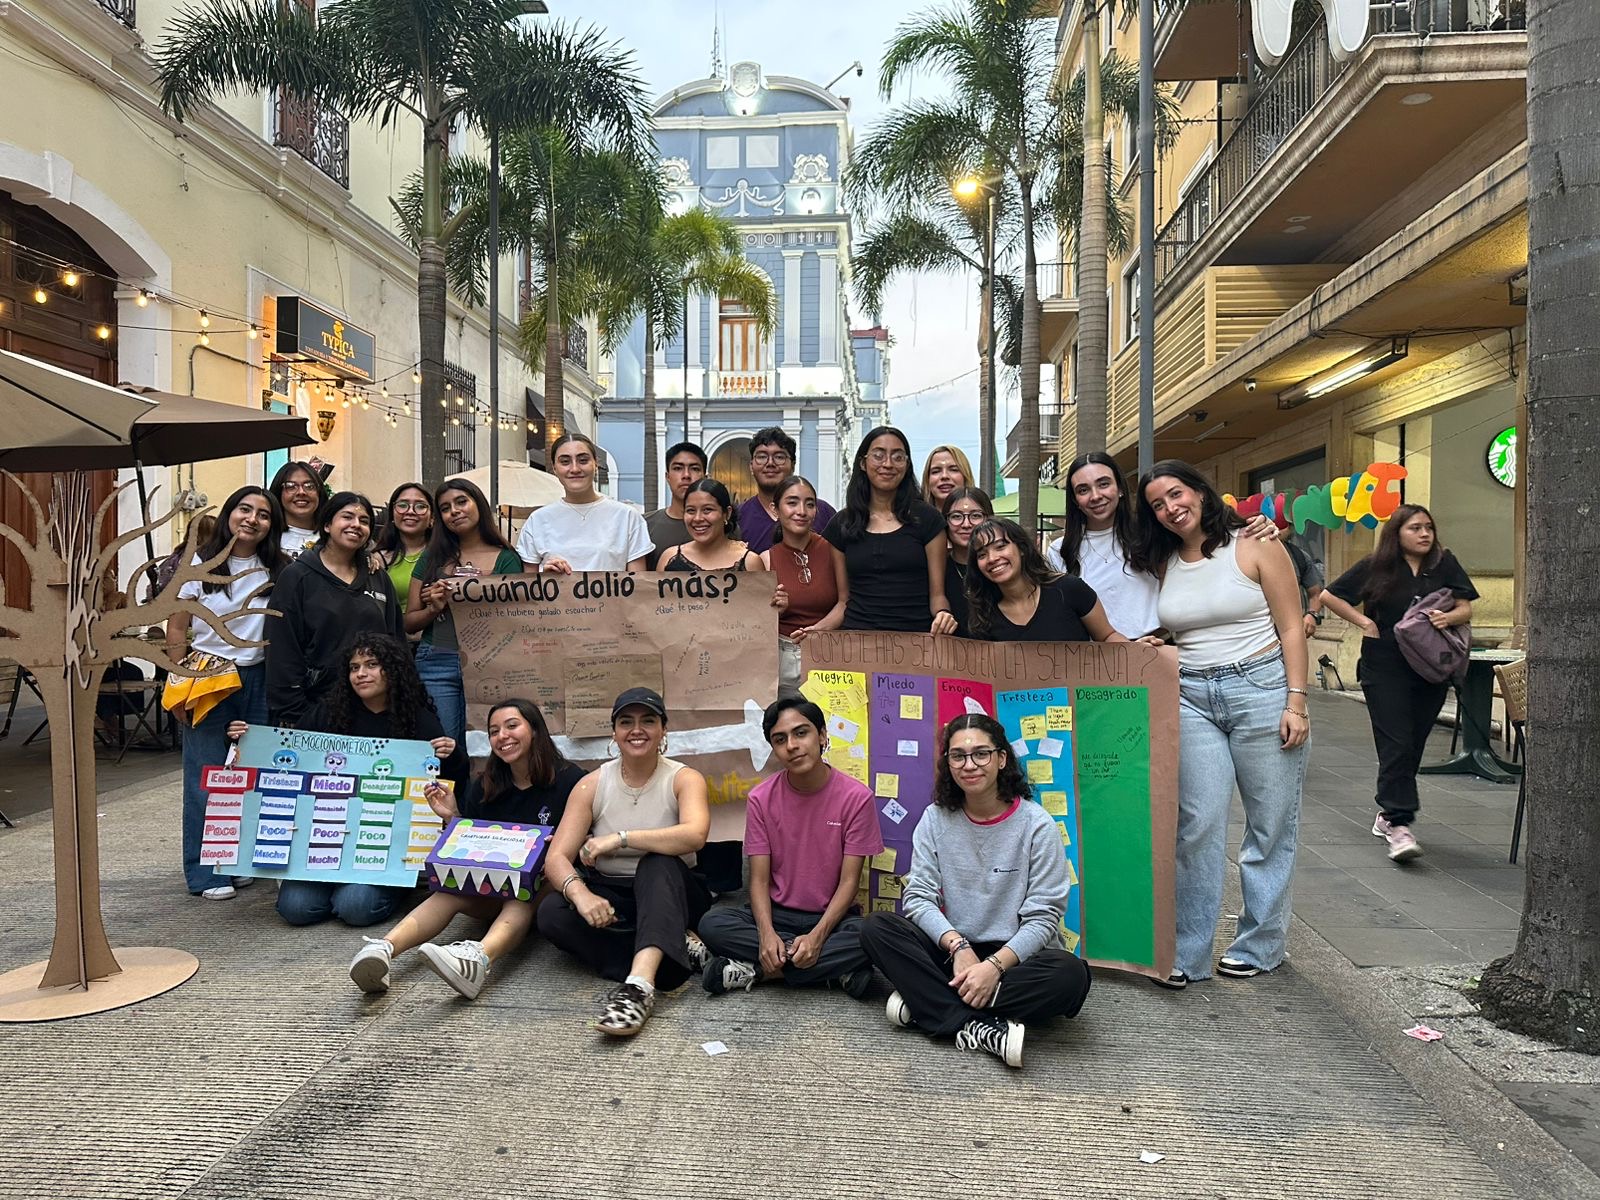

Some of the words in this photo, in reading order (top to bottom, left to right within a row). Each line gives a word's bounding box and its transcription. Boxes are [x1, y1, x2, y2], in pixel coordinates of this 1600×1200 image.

[322, 331, 355, 359] TYPICA
[452, 573, 560, 602] ¿Cuándo
[572, 571, 636, 599] dolió
[657, 571, 738, 604] más?
[494, 607, 505, 617] te
[854, 633, 873, 664] TE
[875, 633, 904, 665] HAS
[911, 635, 976, 676] SENTIDO
[981, 643, 997, 678] EN
[1004, 643, 1027, 681] LA
[1037, 643, 1129, 685] SEMANA
[877, 675, 915, 690] Miedo
[942, 681, 972, 695] Enojo
[1001, 690, 1054, 703] Tristeza
[1075, 688, 1138, 702] Desagrado
[210, 773, 244, 785] Enojo
[262, 775, 300, 787] Tristeza
[313, 779, 351, 791] Miedo
[362, 782, 401, 792] Desagrado
[205, 824, 237, 835] Poco
[260, 824, 287, 835] Poco
[312, 827, 340, 838] Poco
[359, 830, 386, 840] Poco
[411, 831, 437, 841] Poco
[201, 849, 234, 858] Mucho
[254, 849, 287, 859] Mucho
[308, 855, 339, 864] Mucho
[354, 855, 385, 864] Mucho
